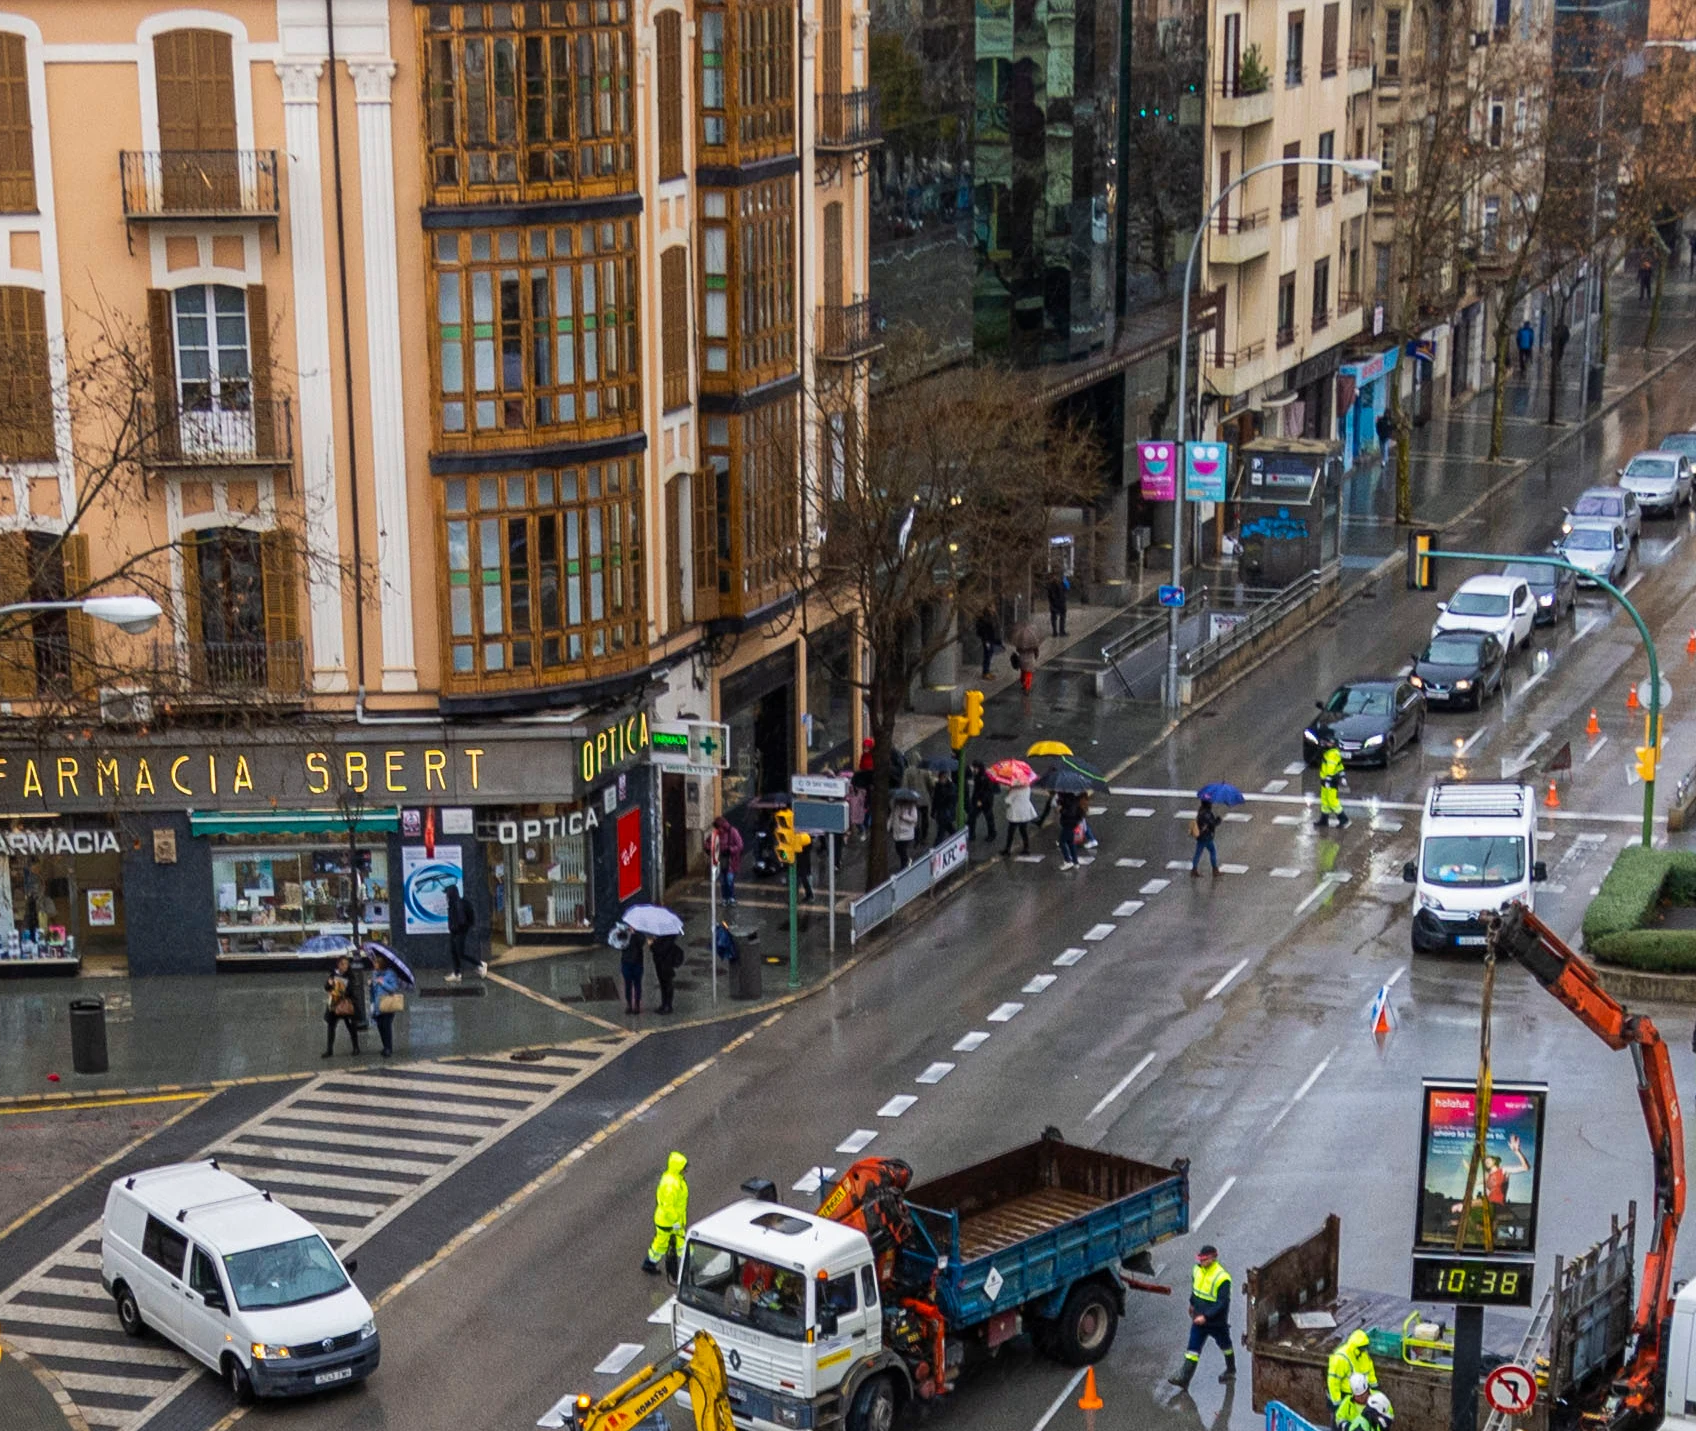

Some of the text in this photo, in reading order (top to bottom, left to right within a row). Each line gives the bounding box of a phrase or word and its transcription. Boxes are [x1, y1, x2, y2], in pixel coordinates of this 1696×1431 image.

[582, 711, 650, 783] OPTICA
[305, 748, 486, 794] SBERT
[498, 806, 599, 845] OPTICA
[1437, 1268, 1519, 1295] 10:38
[635, 1386, 669, 1417] KOMATSU
